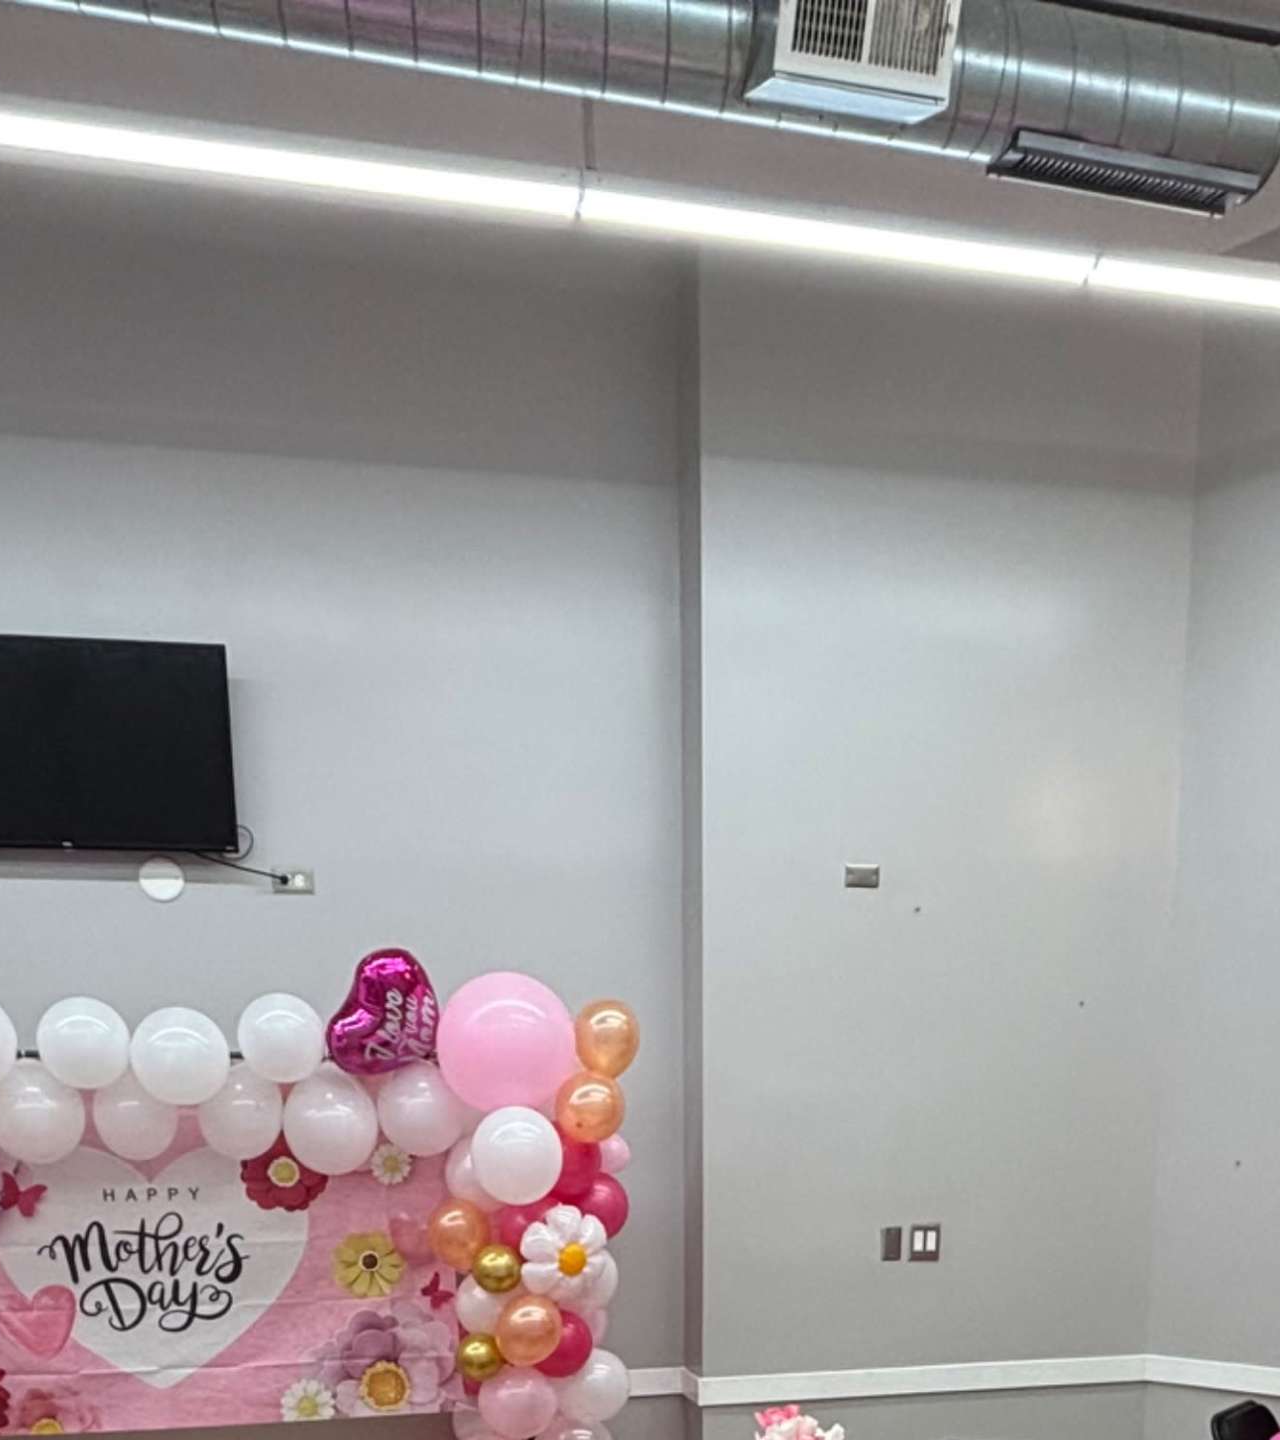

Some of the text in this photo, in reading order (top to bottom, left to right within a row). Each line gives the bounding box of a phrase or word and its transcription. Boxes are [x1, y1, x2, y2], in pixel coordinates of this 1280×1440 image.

[376, 987, 404, 1043] love
[102, 1187, 201, 1202] HAPPY
[37, 1212, 250, 1284] Mother's
[79, 1277, 233, 1332] Day
